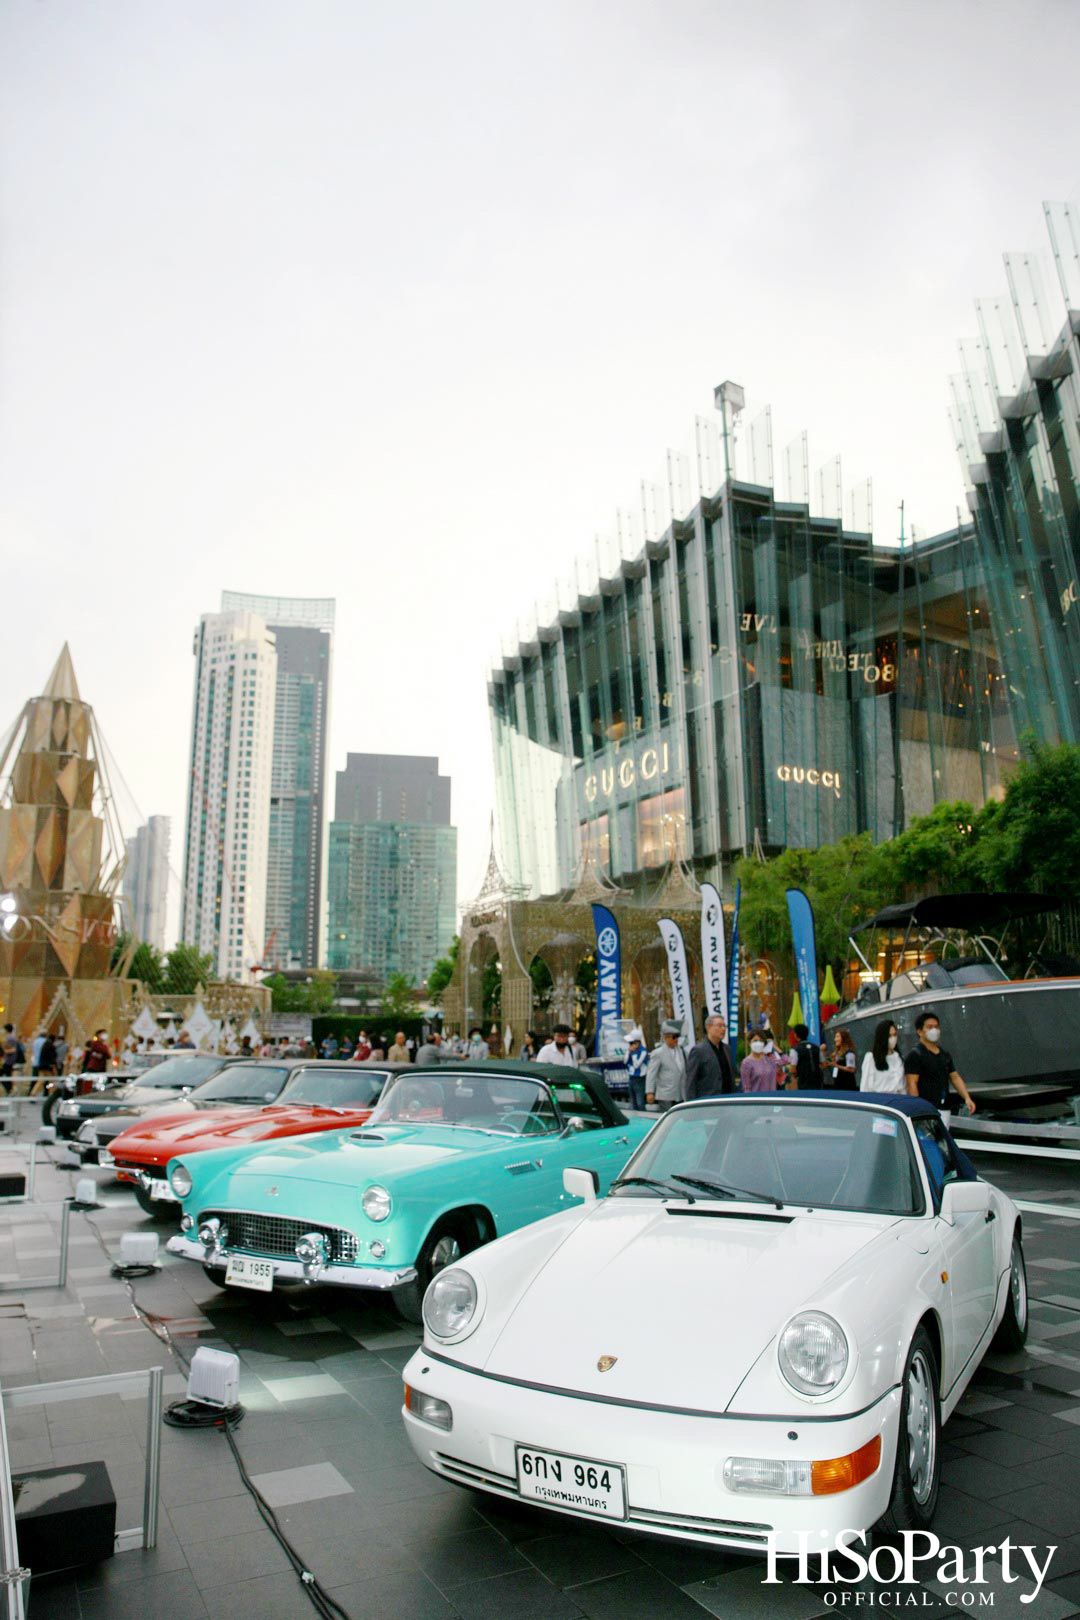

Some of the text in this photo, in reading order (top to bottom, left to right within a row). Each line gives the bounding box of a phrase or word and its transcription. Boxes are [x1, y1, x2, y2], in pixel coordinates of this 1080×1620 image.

[585, 743, 669, 802] GUCCI
[777, 765, 841, 789] GUCCI
[249, 1263, 271, 1278] 1955
[574, 1464, 611, 1493] 964
[535, 1485, 607, 1510] กรุงเทพมหานคร
